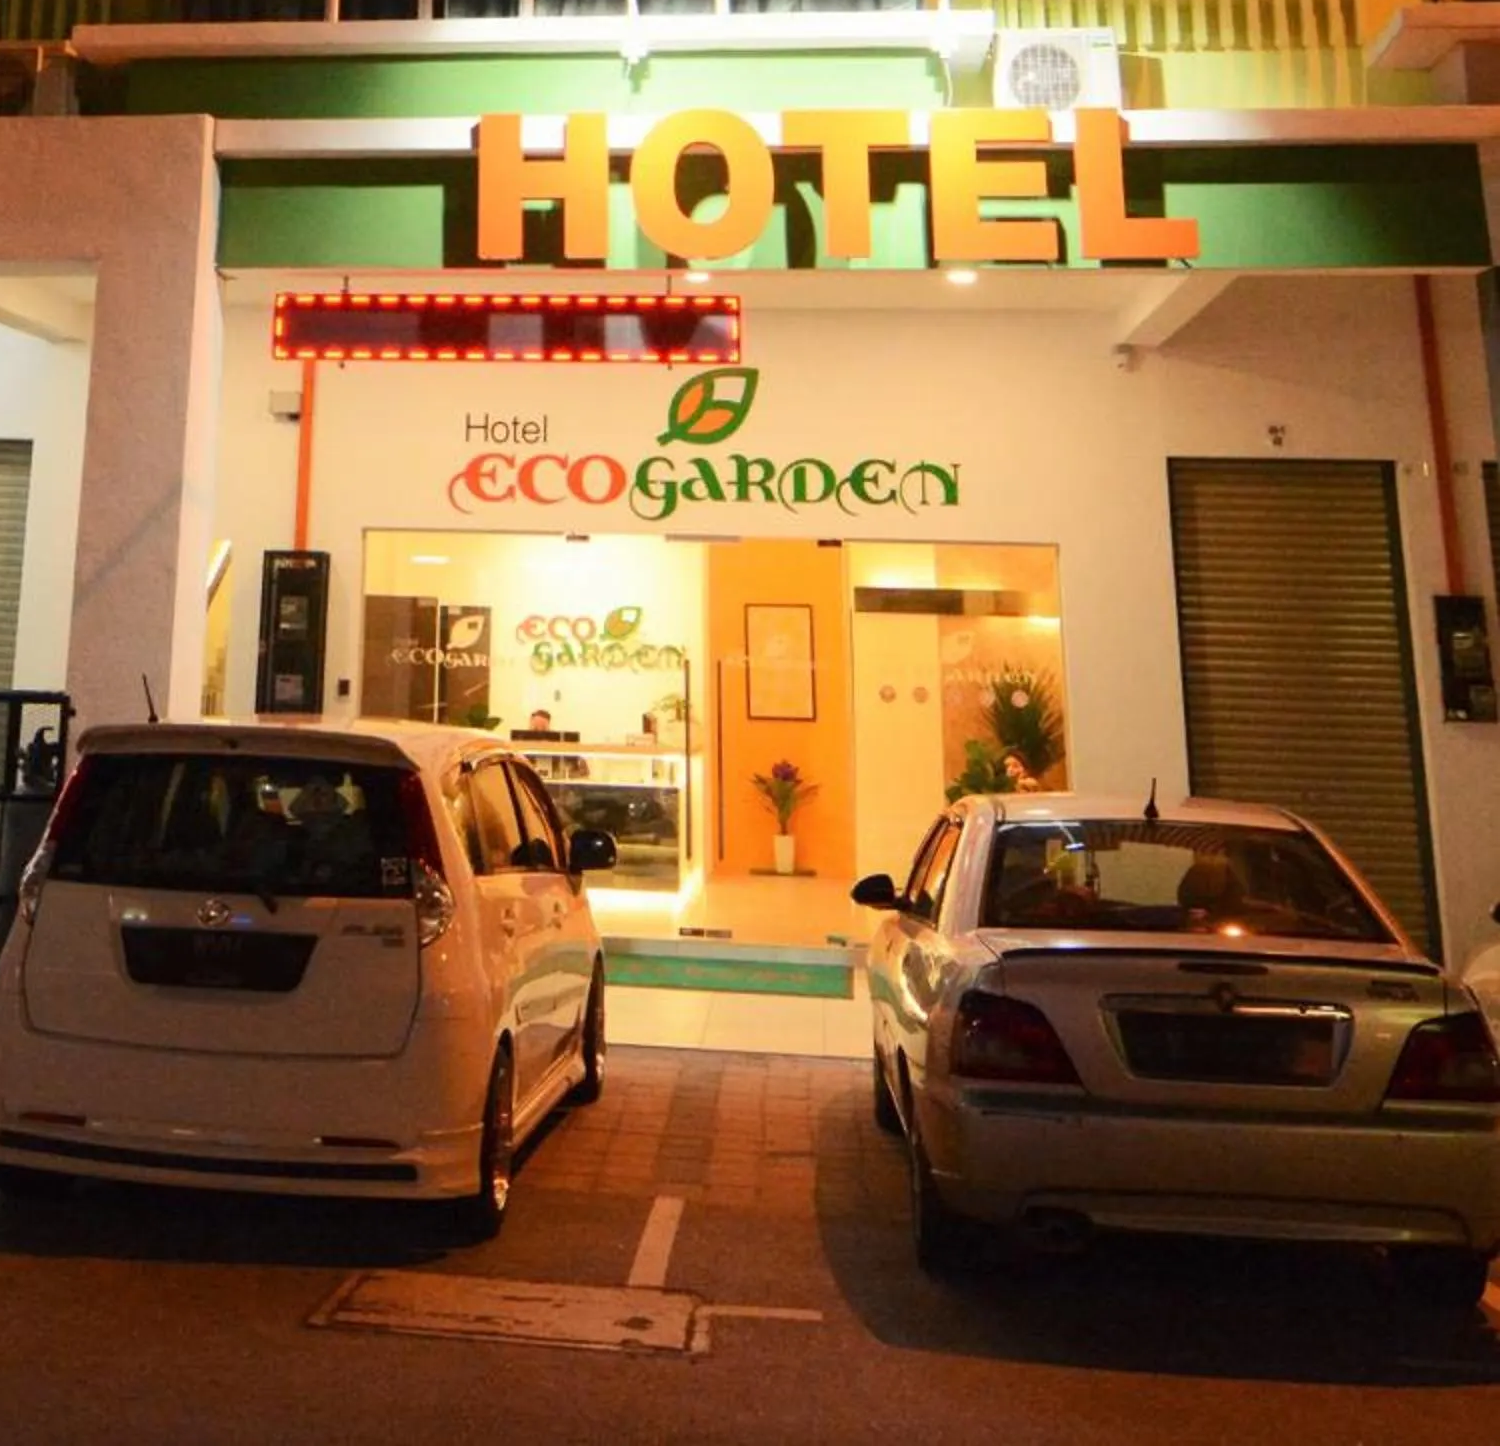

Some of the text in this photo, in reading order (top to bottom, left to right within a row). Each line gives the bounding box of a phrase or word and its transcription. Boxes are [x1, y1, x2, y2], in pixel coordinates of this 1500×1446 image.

[476, 108, 1200, 260] HOTEL
[464, 413, 548, 444] Hotel
[516, 614, 597, 644] ECO
